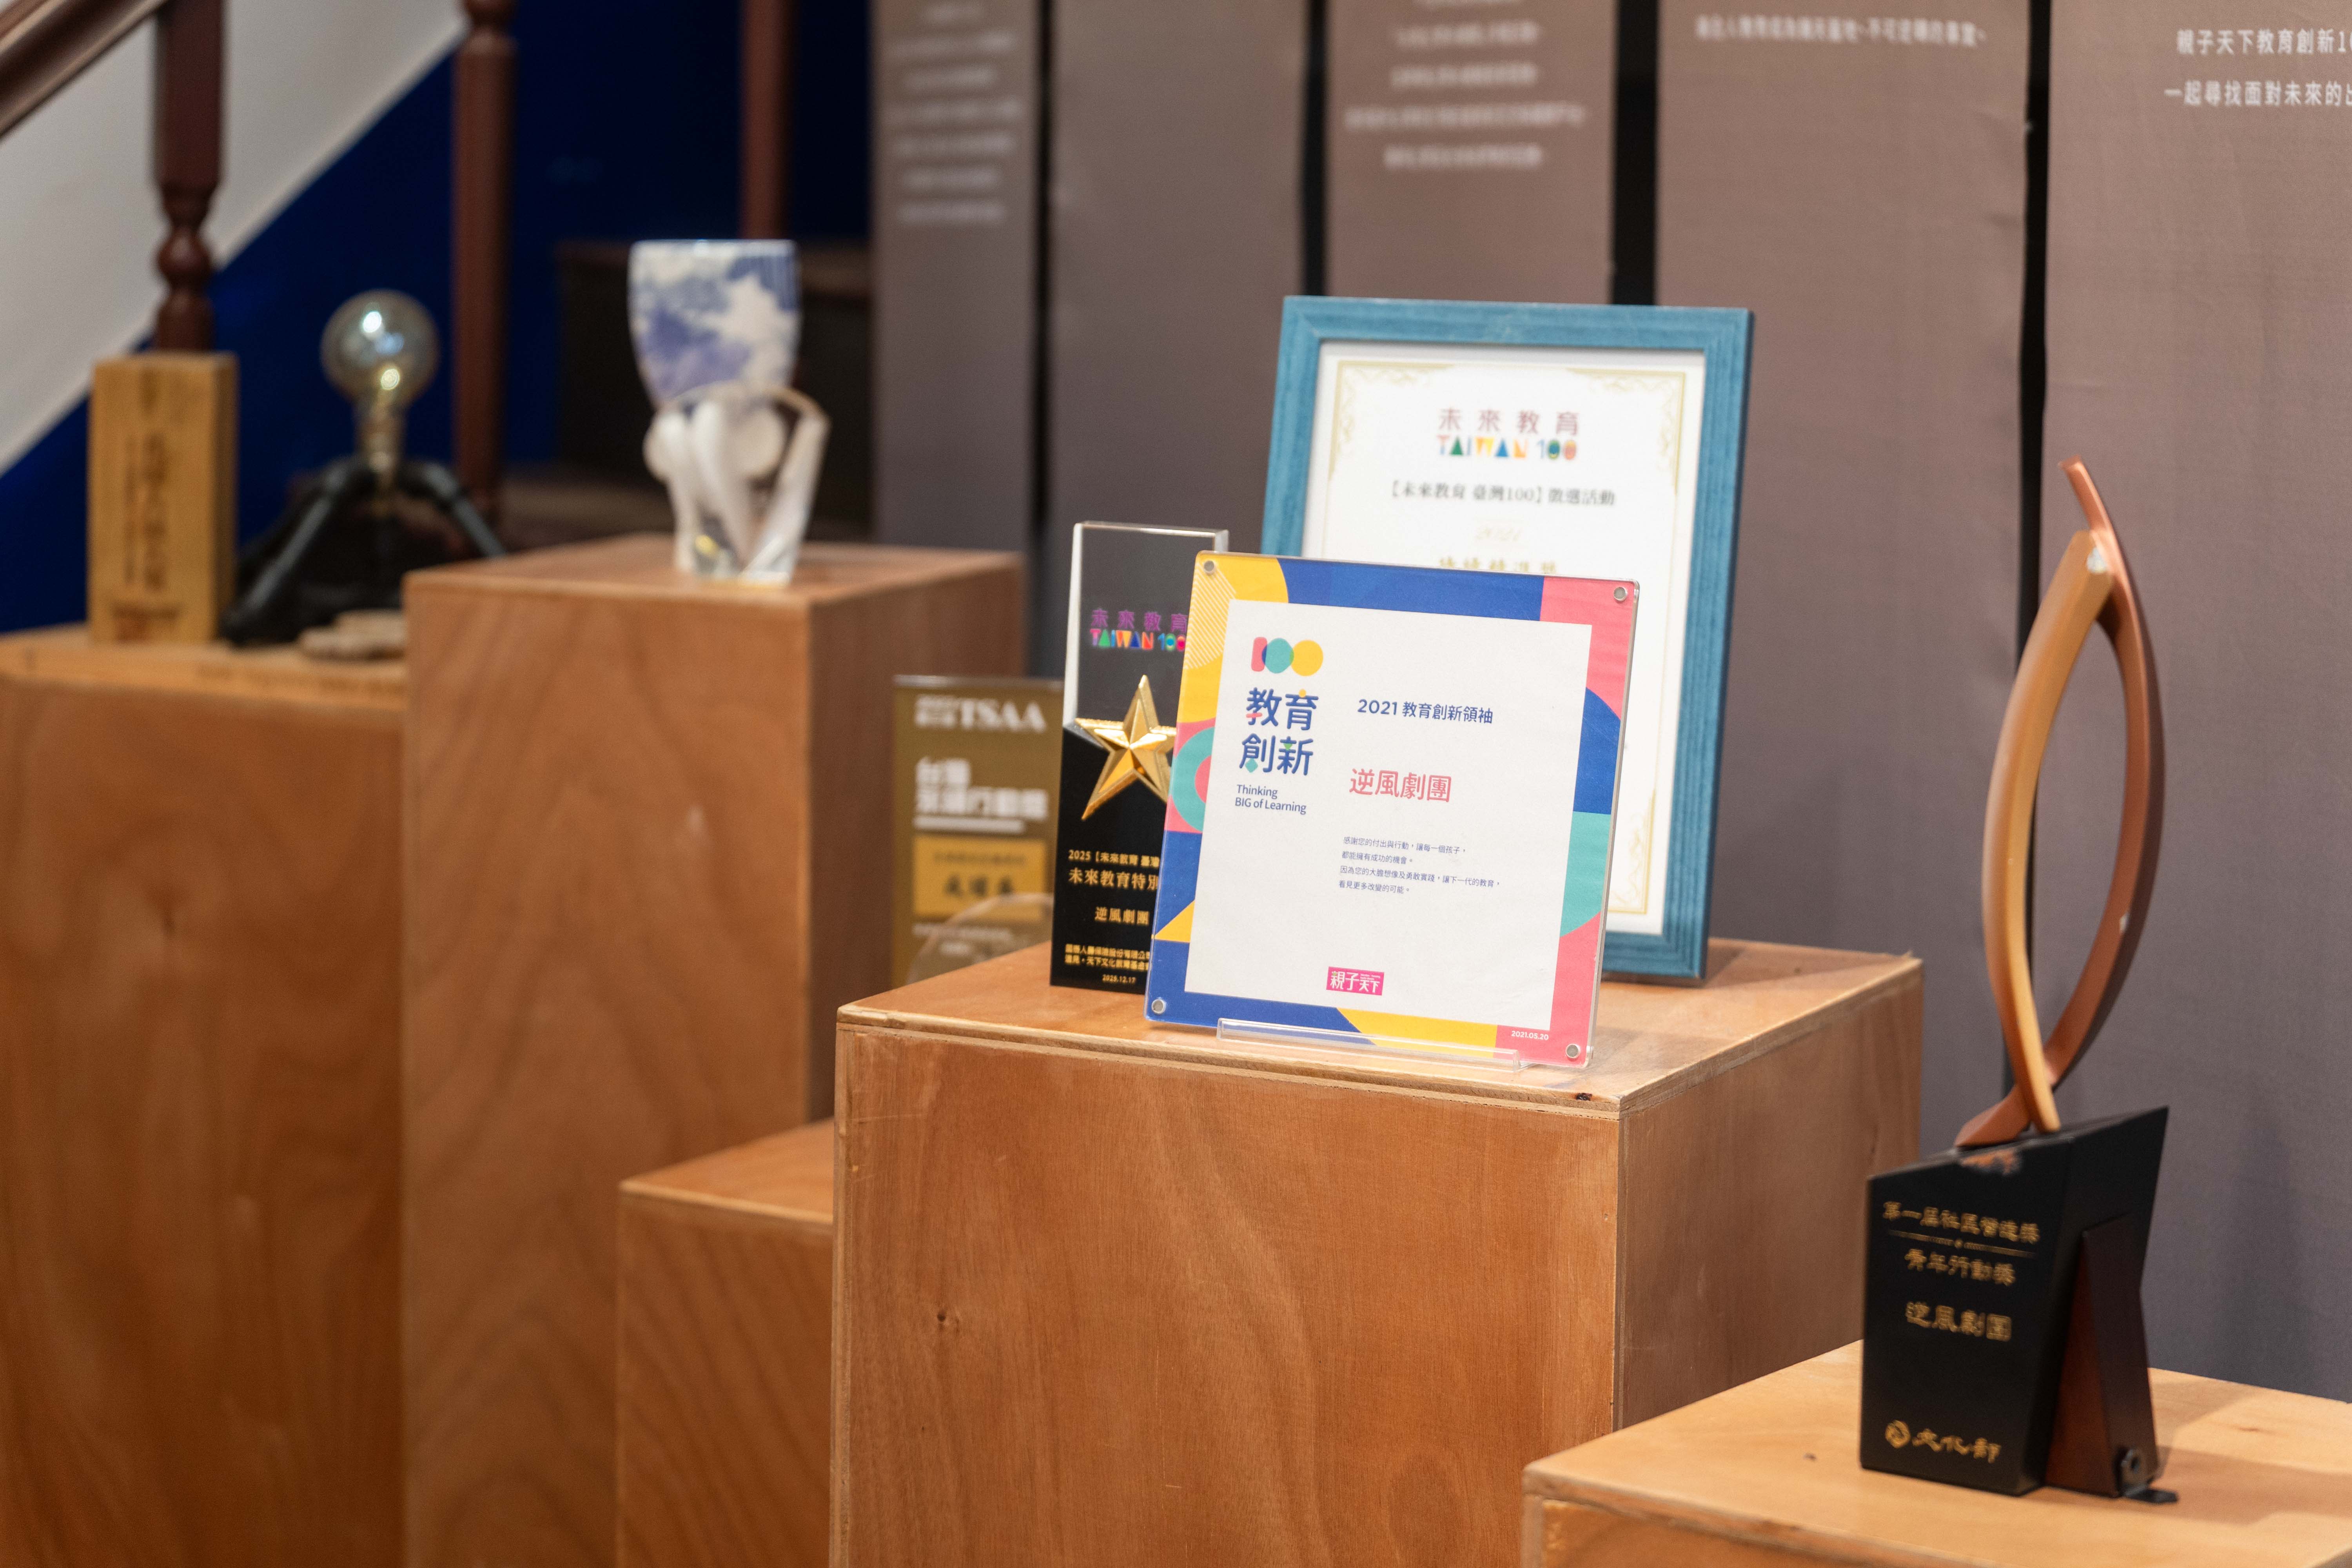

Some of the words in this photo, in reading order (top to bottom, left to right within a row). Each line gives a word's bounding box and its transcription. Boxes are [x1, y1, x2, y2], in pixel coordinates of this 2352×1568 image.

[2177, 28, 2352, 55] 親子天下教育創新1
[1439, 408, 1579, 435] 未來教育
[1437, 434, 1528, 458] TAIWAN
[1537, 439, 1576, 460] 100
[1091, 608, 1188, 633] 未來教育
[1090, 628, 1153, 650] TAIWAN
[1158, 633, 1186, 651] 100
[1246, 687, 1319, 730] 教育
[1357, 699, 1397, 715] 2021
[1402, 701, 1493, 724] 教育創新領袖
[1239, 733, 1313, 776] 創新
[1237, 784, 1278, 799] Thinking
[1349, 768, 1452, 802] 逆風劇團
[1235, 797, 1251, 807] BIG
[1254, 799, 1263, 808] of
[1265, 800, 1307, 815] Learning
[1068, 849, 1091, 861] 2025
[1095, 906, 1149, 926] 逆風劇團
[1330, 971, 1380, 993] 親子天下
[1511, 1031, 1549, 1041] 2021.05.20
